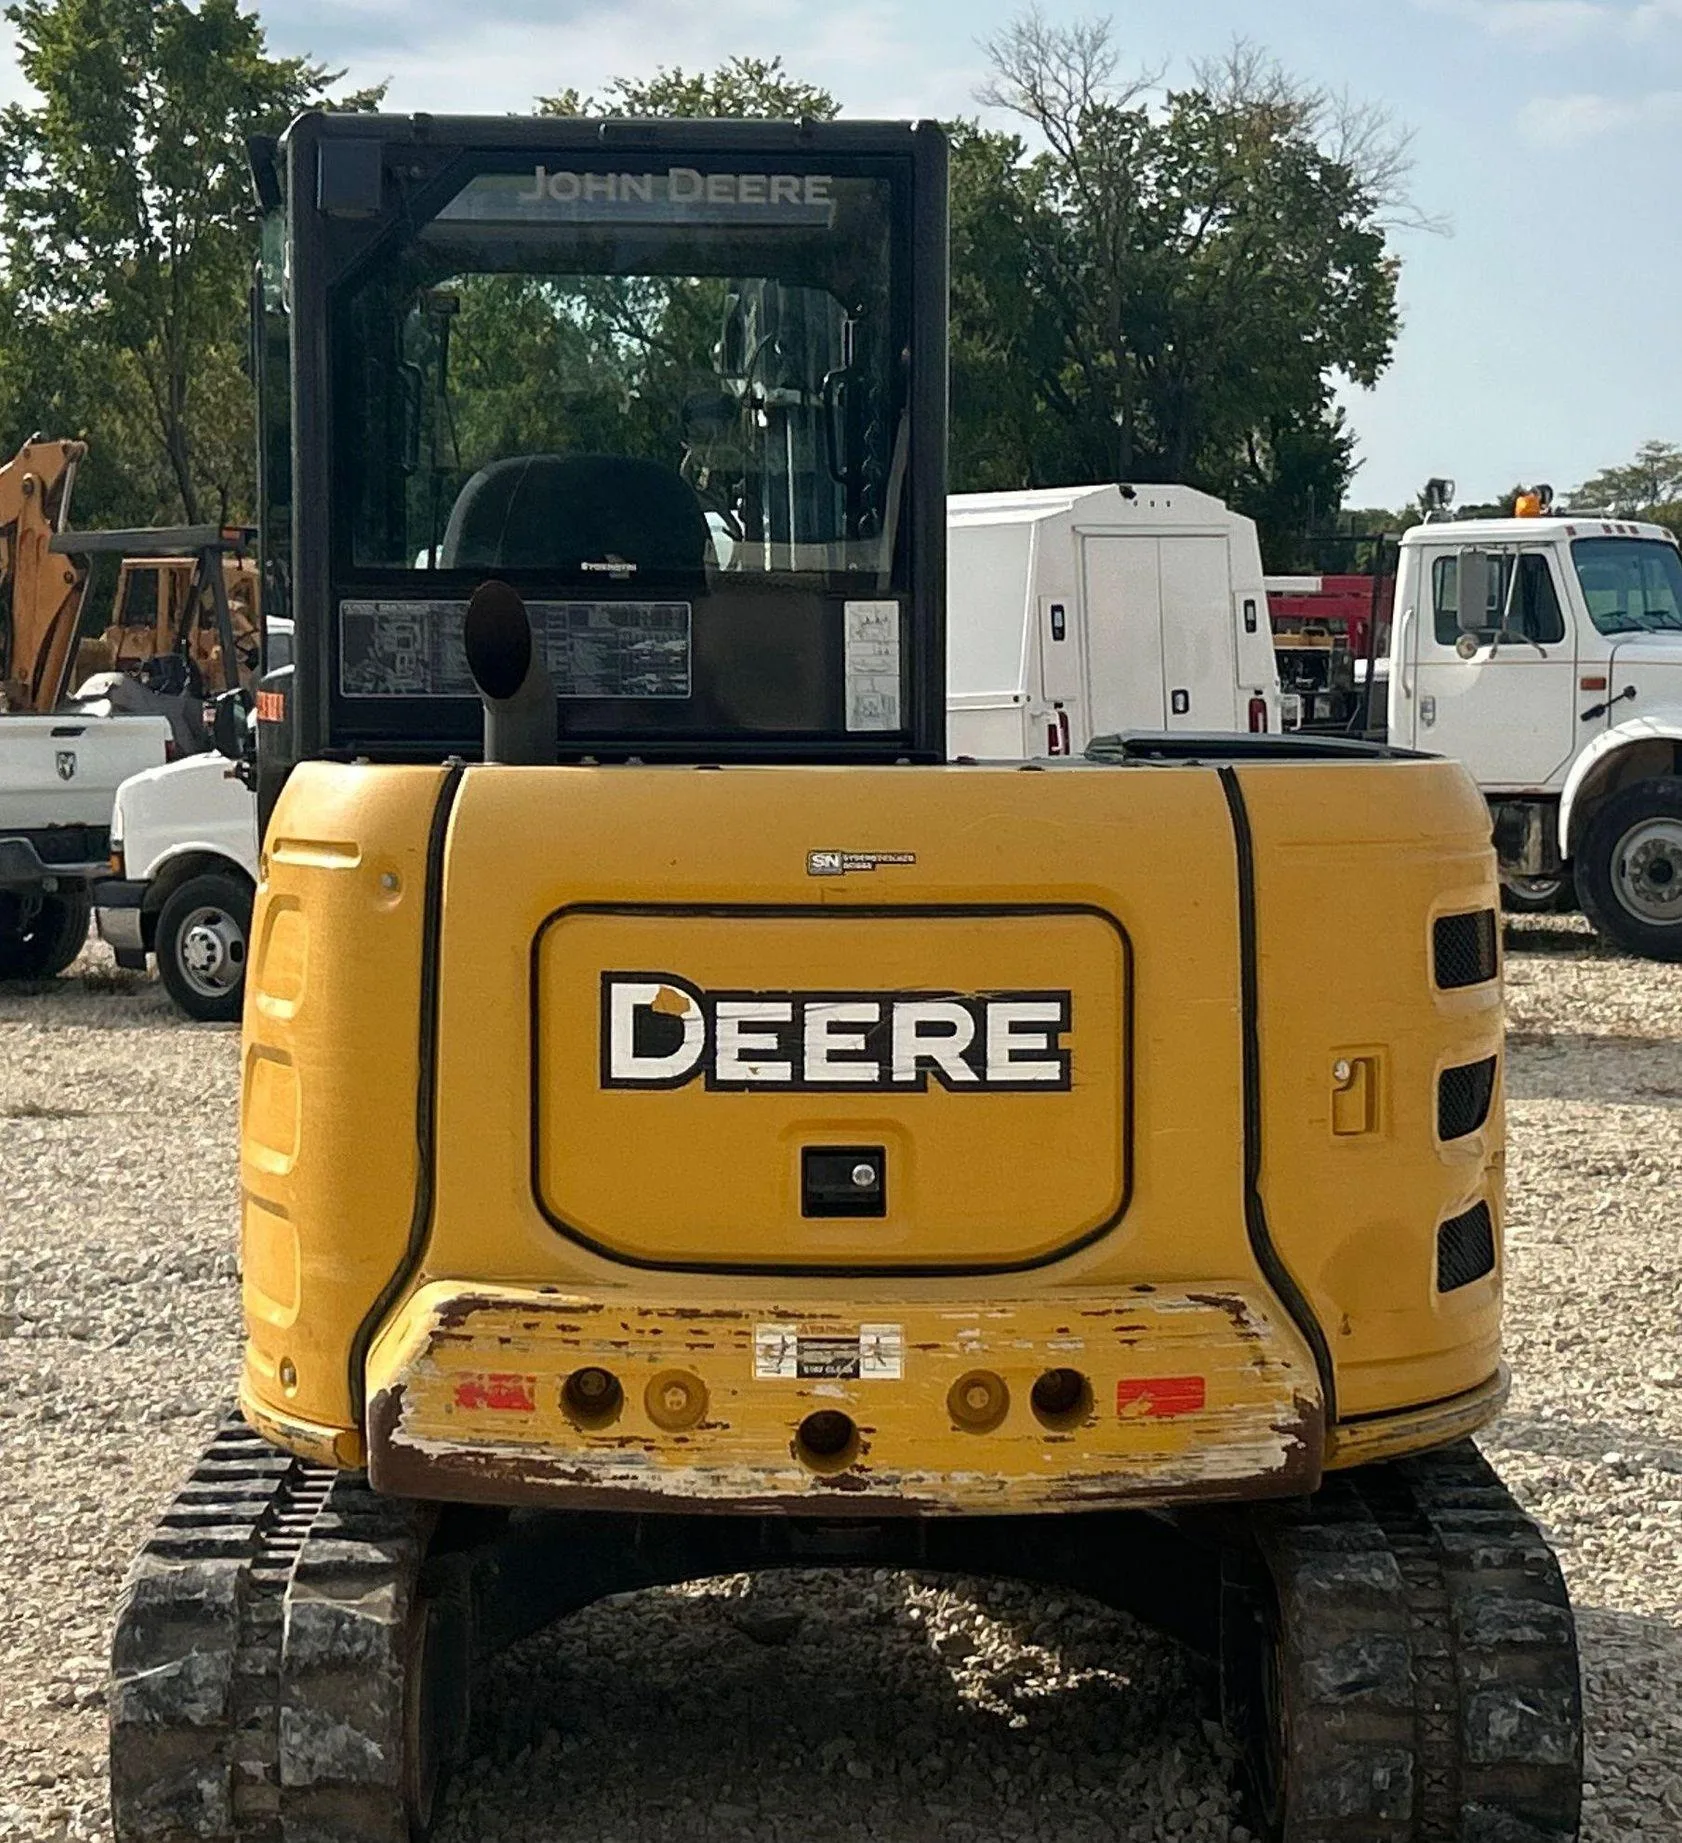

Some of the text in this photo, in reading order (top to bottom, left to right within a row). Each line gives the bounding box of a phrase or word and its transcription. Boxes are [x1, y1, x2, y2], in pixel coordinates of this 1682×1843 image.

[518, 165, 833, 204] JOHN DEERE
[811, 854, 840, 868] SN
[608, 980, 1063, 1083] DEERE
